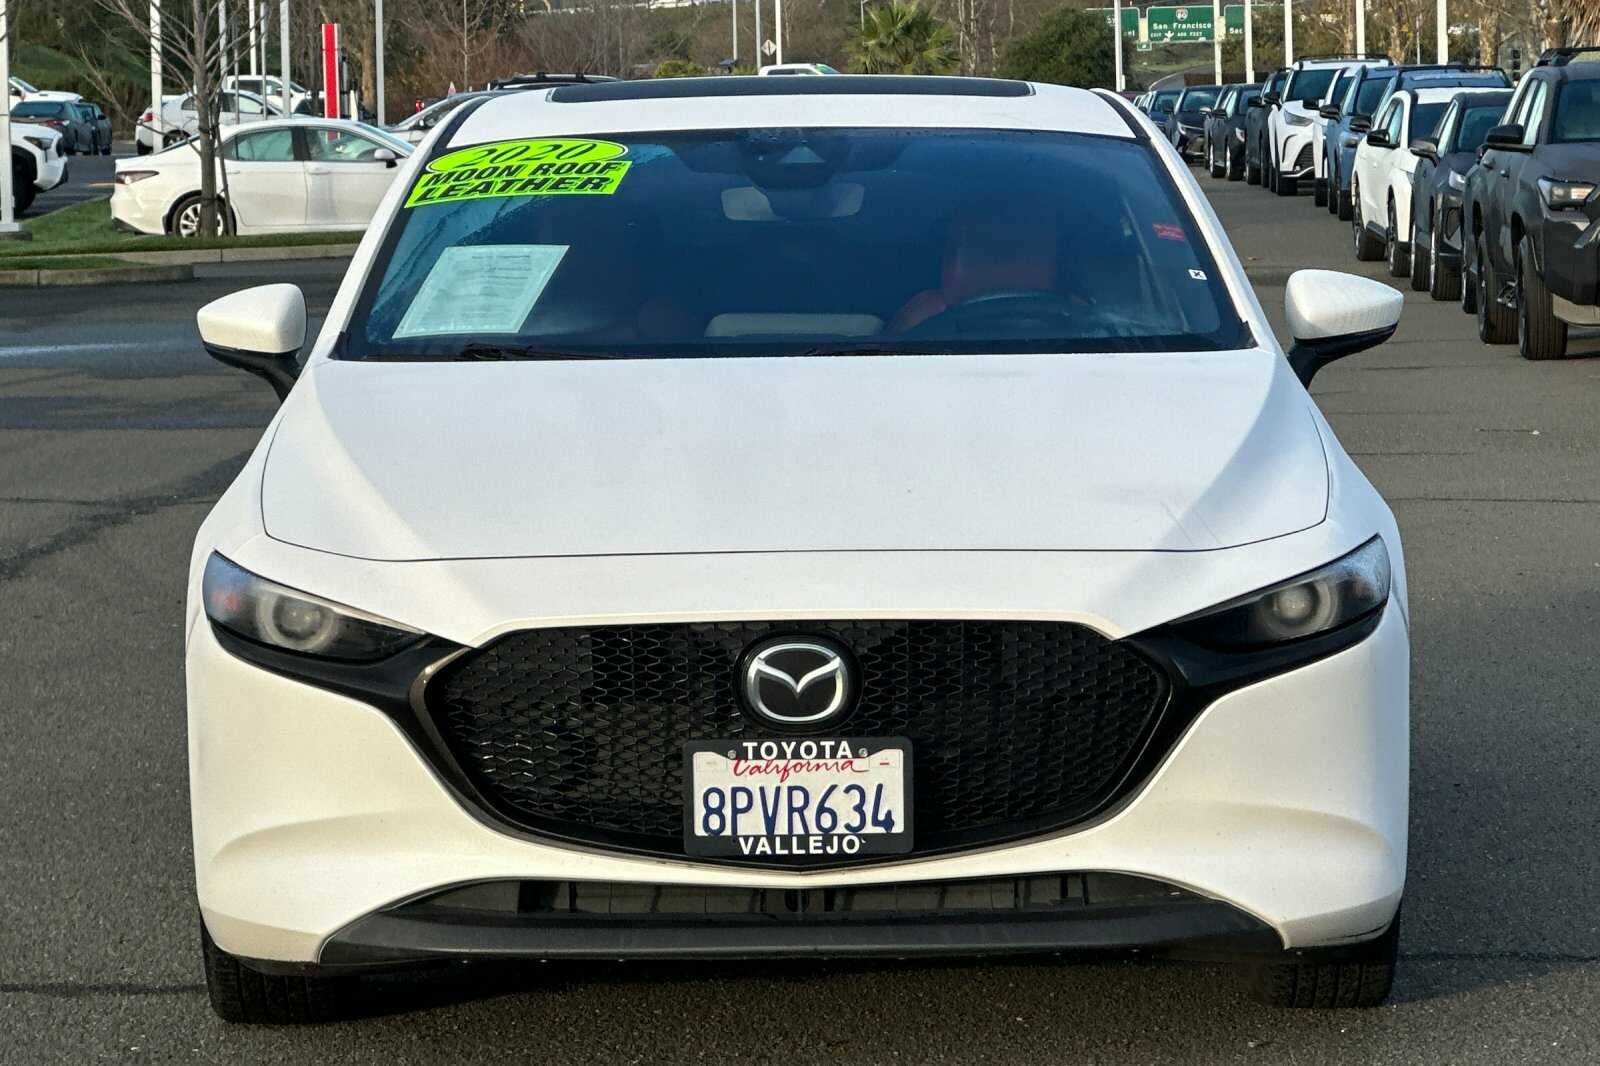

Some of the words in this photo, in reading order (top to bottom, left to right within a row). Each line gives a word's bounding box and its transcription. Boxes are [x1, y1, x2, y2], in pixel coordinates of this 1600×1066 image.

[452, 142, 597, 170] 2020
[422, 163, 521, 187] MOON
[529, 159, 617, 177] ROOF
[414, 175, 614, 202] LEATHER
[742, 740, 852, 760] TOYOTA
[733, 758, 869, 783] California
[702, 783, 895, 836] 8PVR634
[738, 835, 861, 855] VALLEJO
